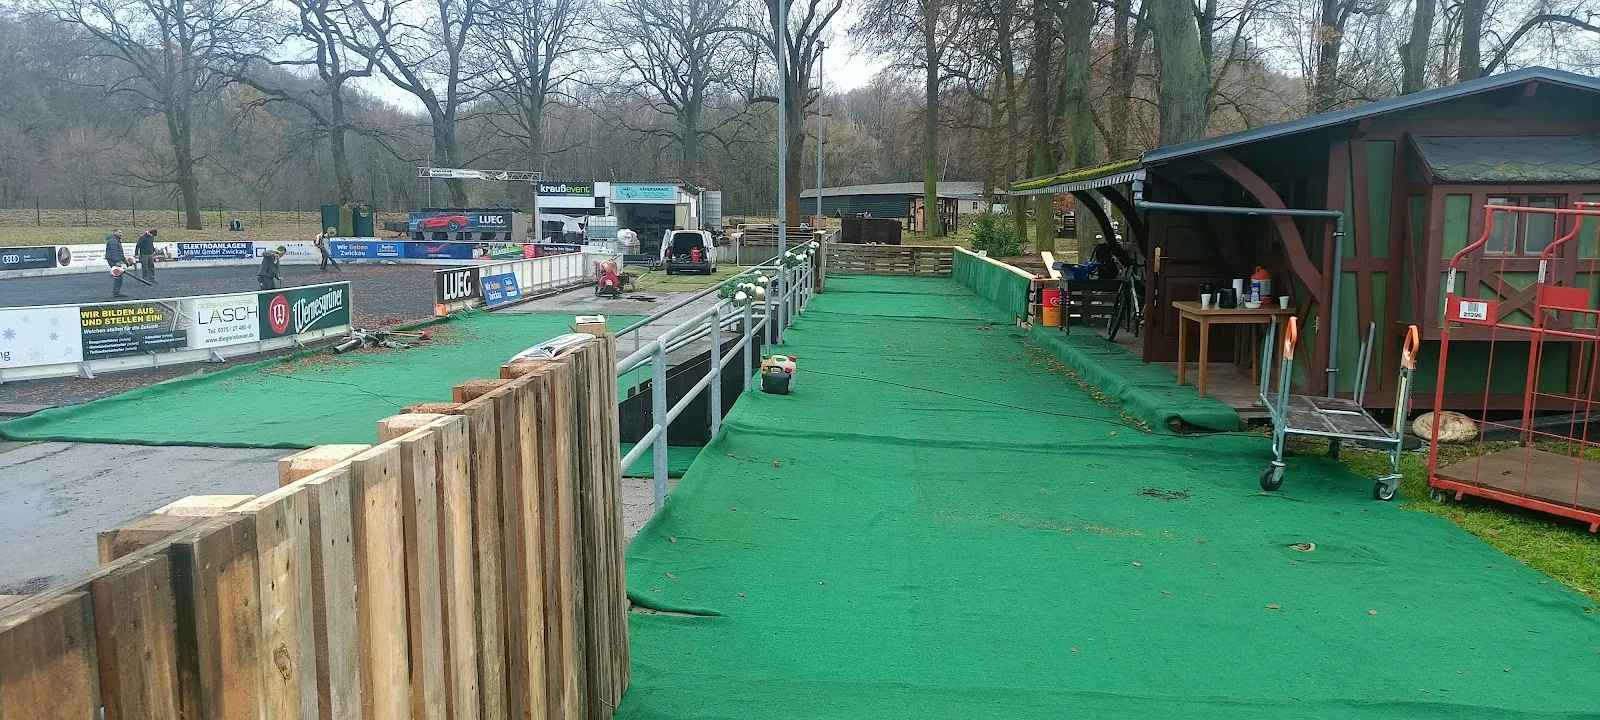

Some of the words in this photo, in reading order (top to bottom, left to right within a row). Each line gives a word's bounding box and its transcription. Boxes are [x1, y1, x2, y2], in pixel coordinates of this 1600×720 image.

[183, 242, 247, 250] ELEKTROANLAGEN
[81, 311, 100, 319] WIR
[102, 308, 135, 317] BILDEN
[137, 307, 154, 315] AUS
[197, 305, 258, 325] LASCH
[292, 288, 343, 334] Wernesgrüner
[82, 318, 102, 327] UND
[105, 315, 144, 325] STELLEN
[146, 314, 163, 322] EIN!
[205, 332, 254, 344] www.diegleisbauer.de
